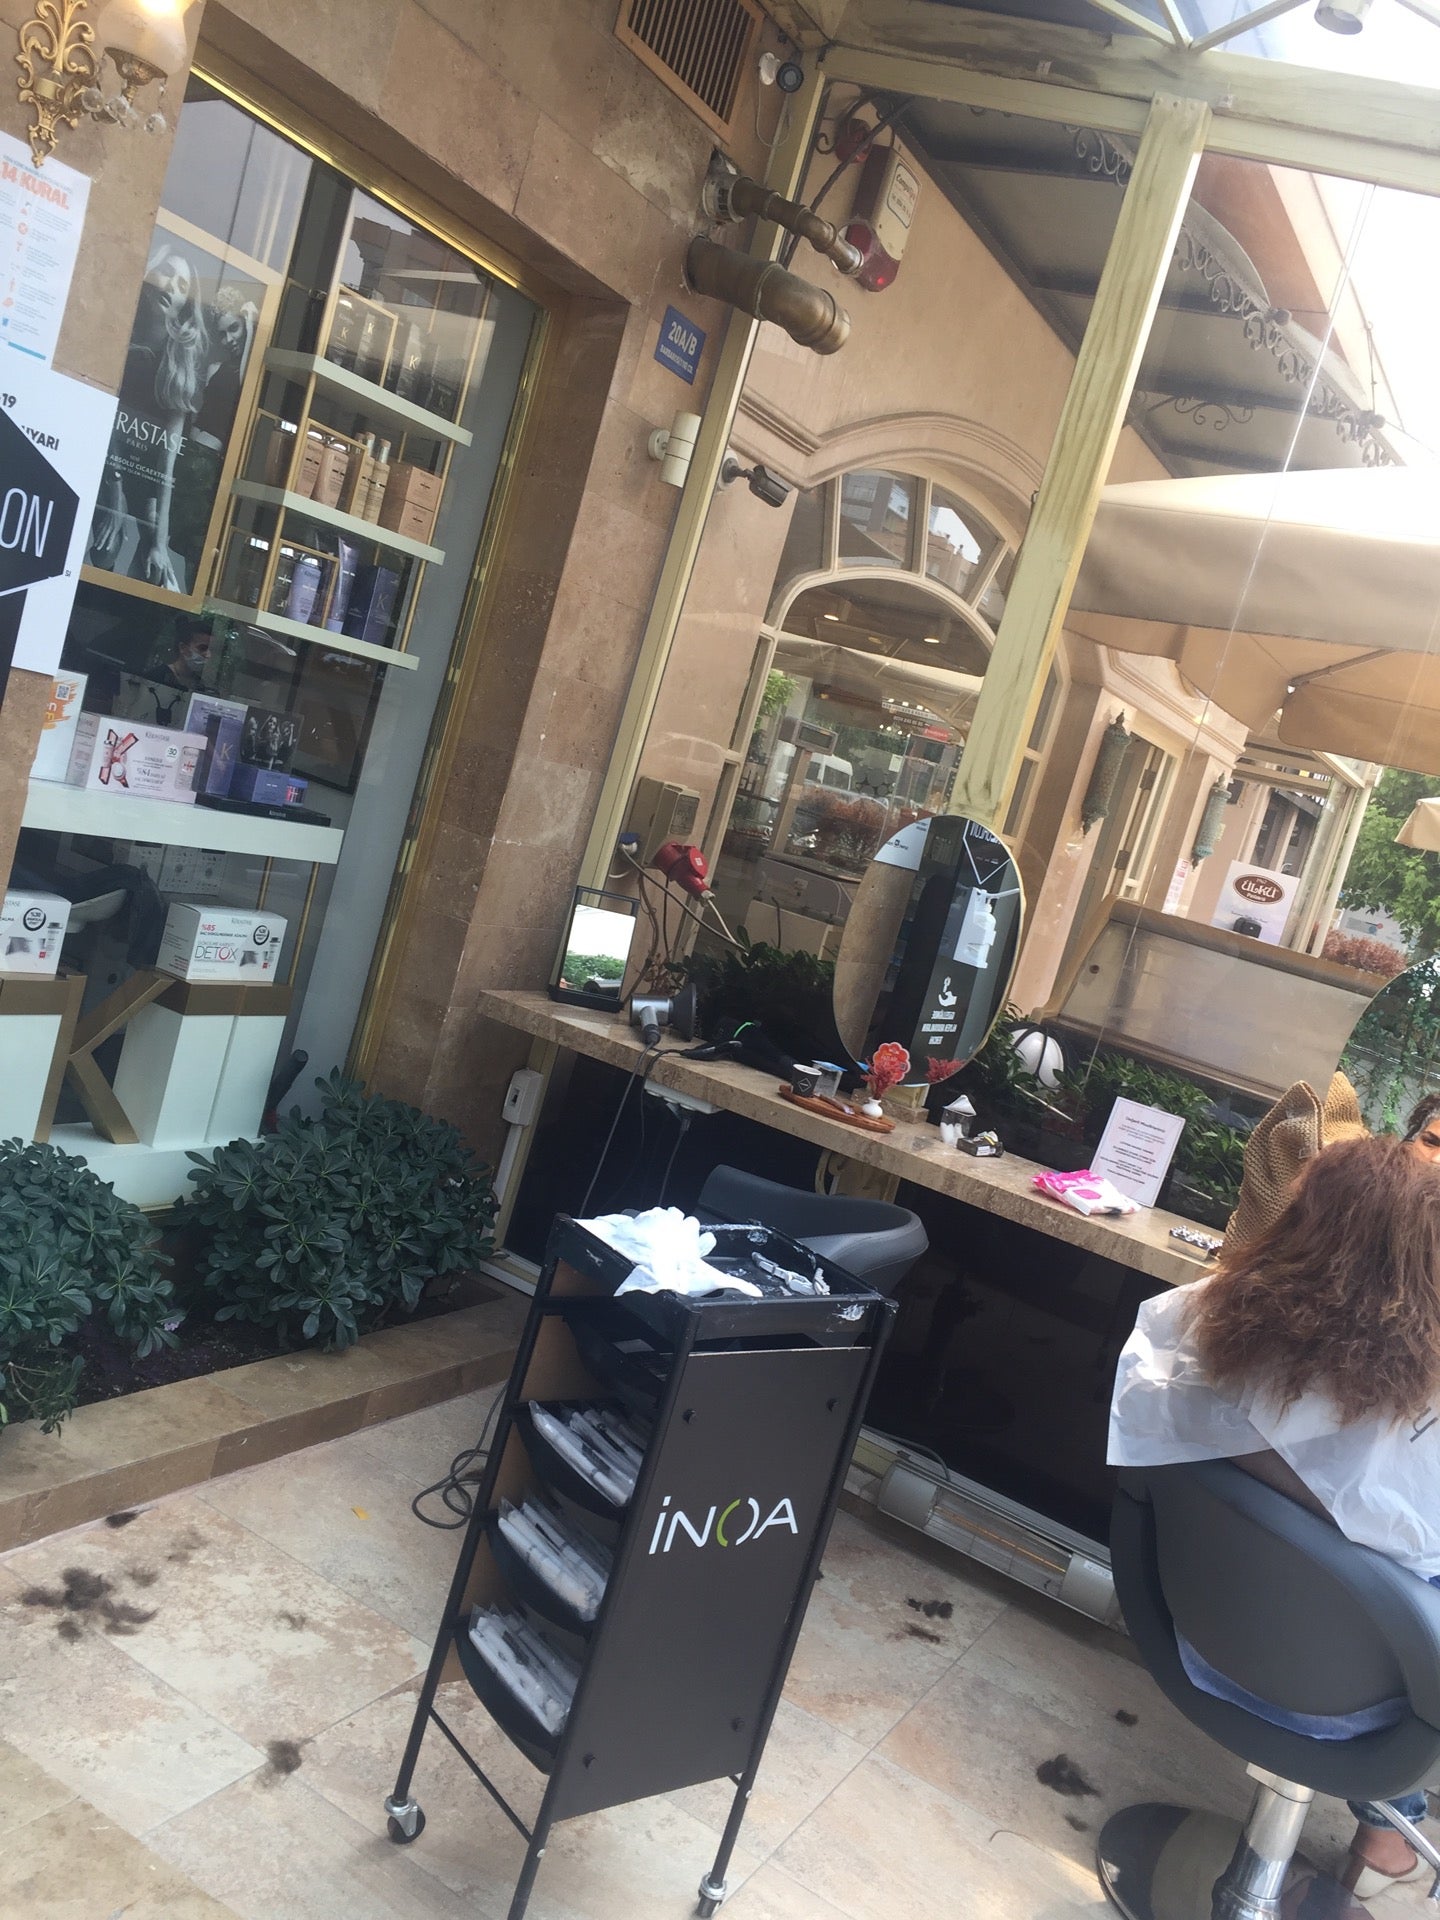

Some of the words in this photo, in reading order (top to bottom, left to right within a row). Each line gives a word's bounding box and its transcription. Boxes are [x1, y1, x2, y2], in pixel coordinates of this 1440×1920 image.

[20, 172, 70, 210] KURAL
[668, 321, 697, 357] 20A/B
[115, 411, 188, 456] RASTASE
[220, 742, 234, 760] K
[194, 945, 239, 961] DETOX
